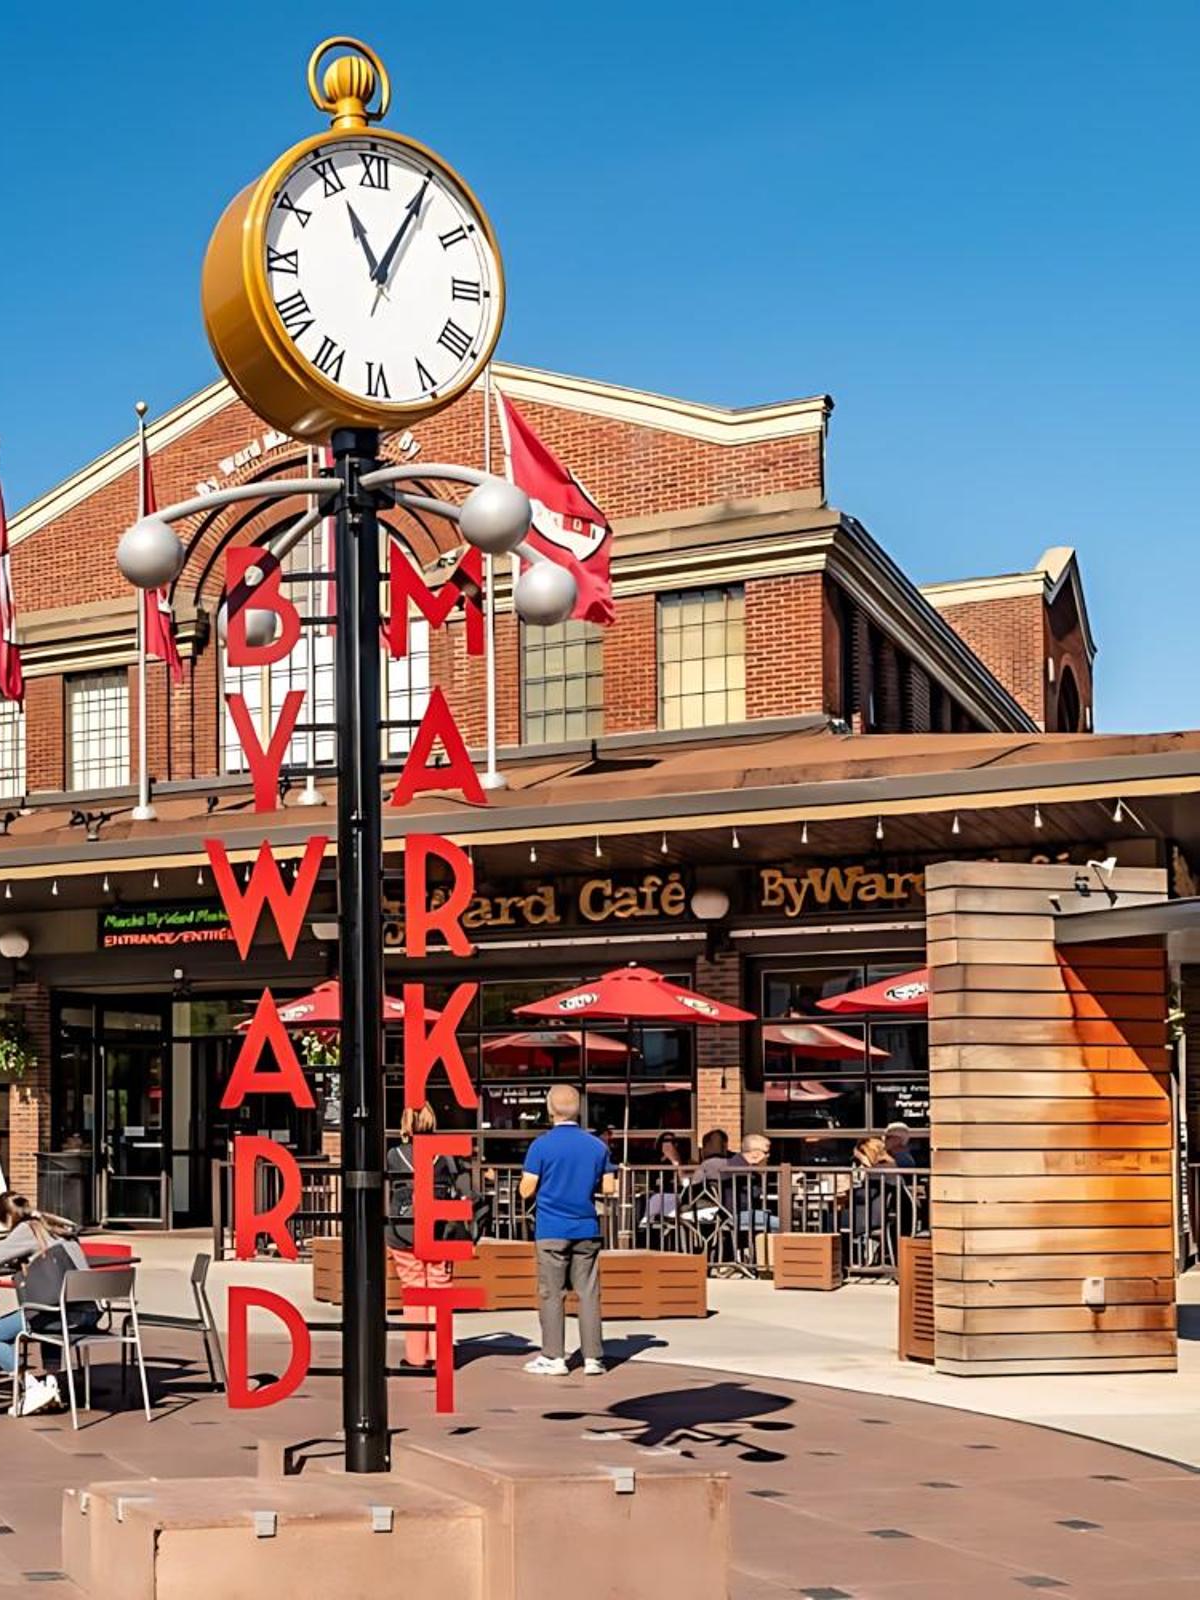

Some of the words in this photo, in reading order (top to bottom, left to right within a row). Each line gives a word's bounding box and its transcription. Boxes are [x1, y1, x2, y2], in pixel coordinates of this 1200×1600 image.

[311, 158, 346, 198] XI
[359, 153, 390, 190] XII
[277, 191, 312, 227] X
[439, 225, 468, 250] II
[267, 247, 298, 275] IX
[452, 277, 480, 305] III
[275, 289, 316, 342] VIII
[437, 319, 474, 361] IIII
[311, 336, 346, 382] VII
[415, 357, 438, 391] V
[365, 362, 391, 398] VI
[579, 872, 686, 921] Café
[390, 536, 488, 1413] MARKET
